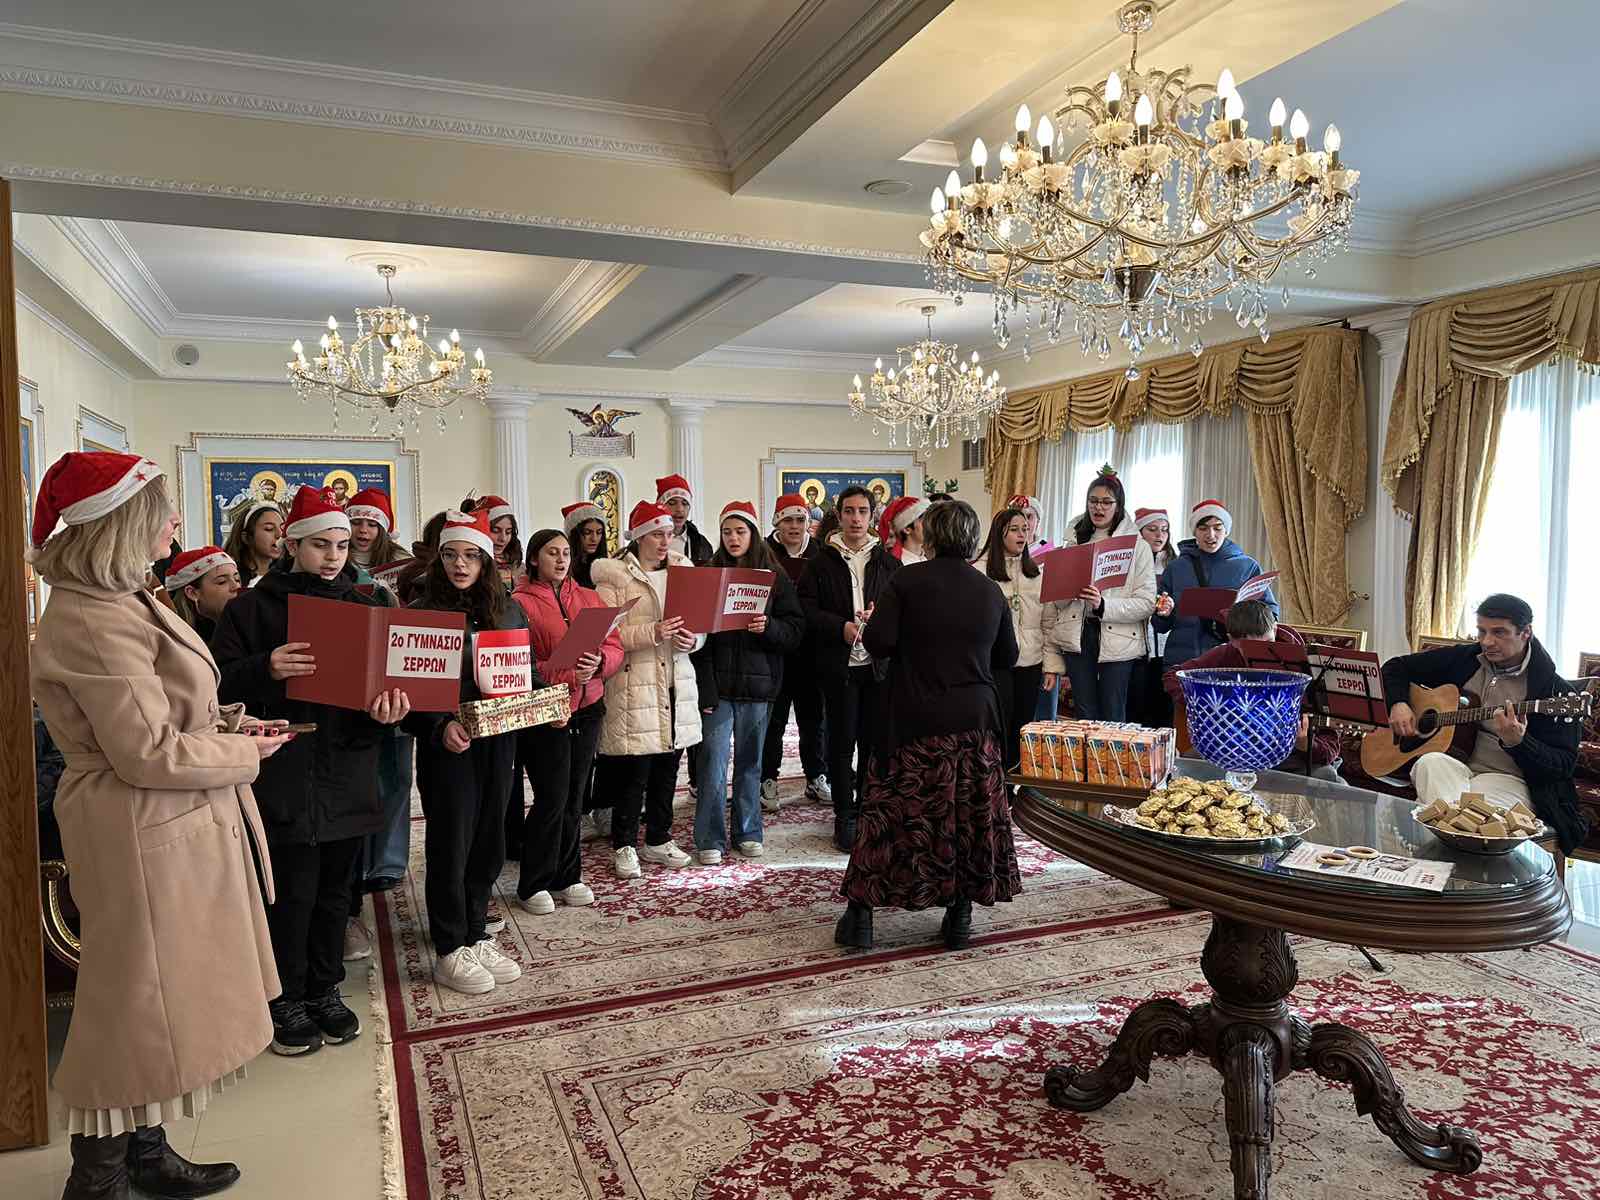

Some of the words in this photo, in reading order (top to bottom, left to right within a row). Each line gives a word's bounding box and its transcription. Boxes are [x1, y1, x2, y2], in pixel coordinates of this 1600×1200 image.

[737, 587, 768, 598] ΓΥΜΝΑΣΙΟ
[733, 601, 757, 611] ΣΕΡΡΩΝ
[391, 632, 403, 648] 2ο
[407, 633, 462, 651] ΓΥΜΝΑΣΙΟ
[403, 656, 446, 673] ΣΕΡΡΩΝ
[480, 654, 491, 668] 2ο
[492, 673, 526, 689] ΣΕΡΡΩΝ
[1337, 677, 1369, 692] ΣΕΡΡΩ
